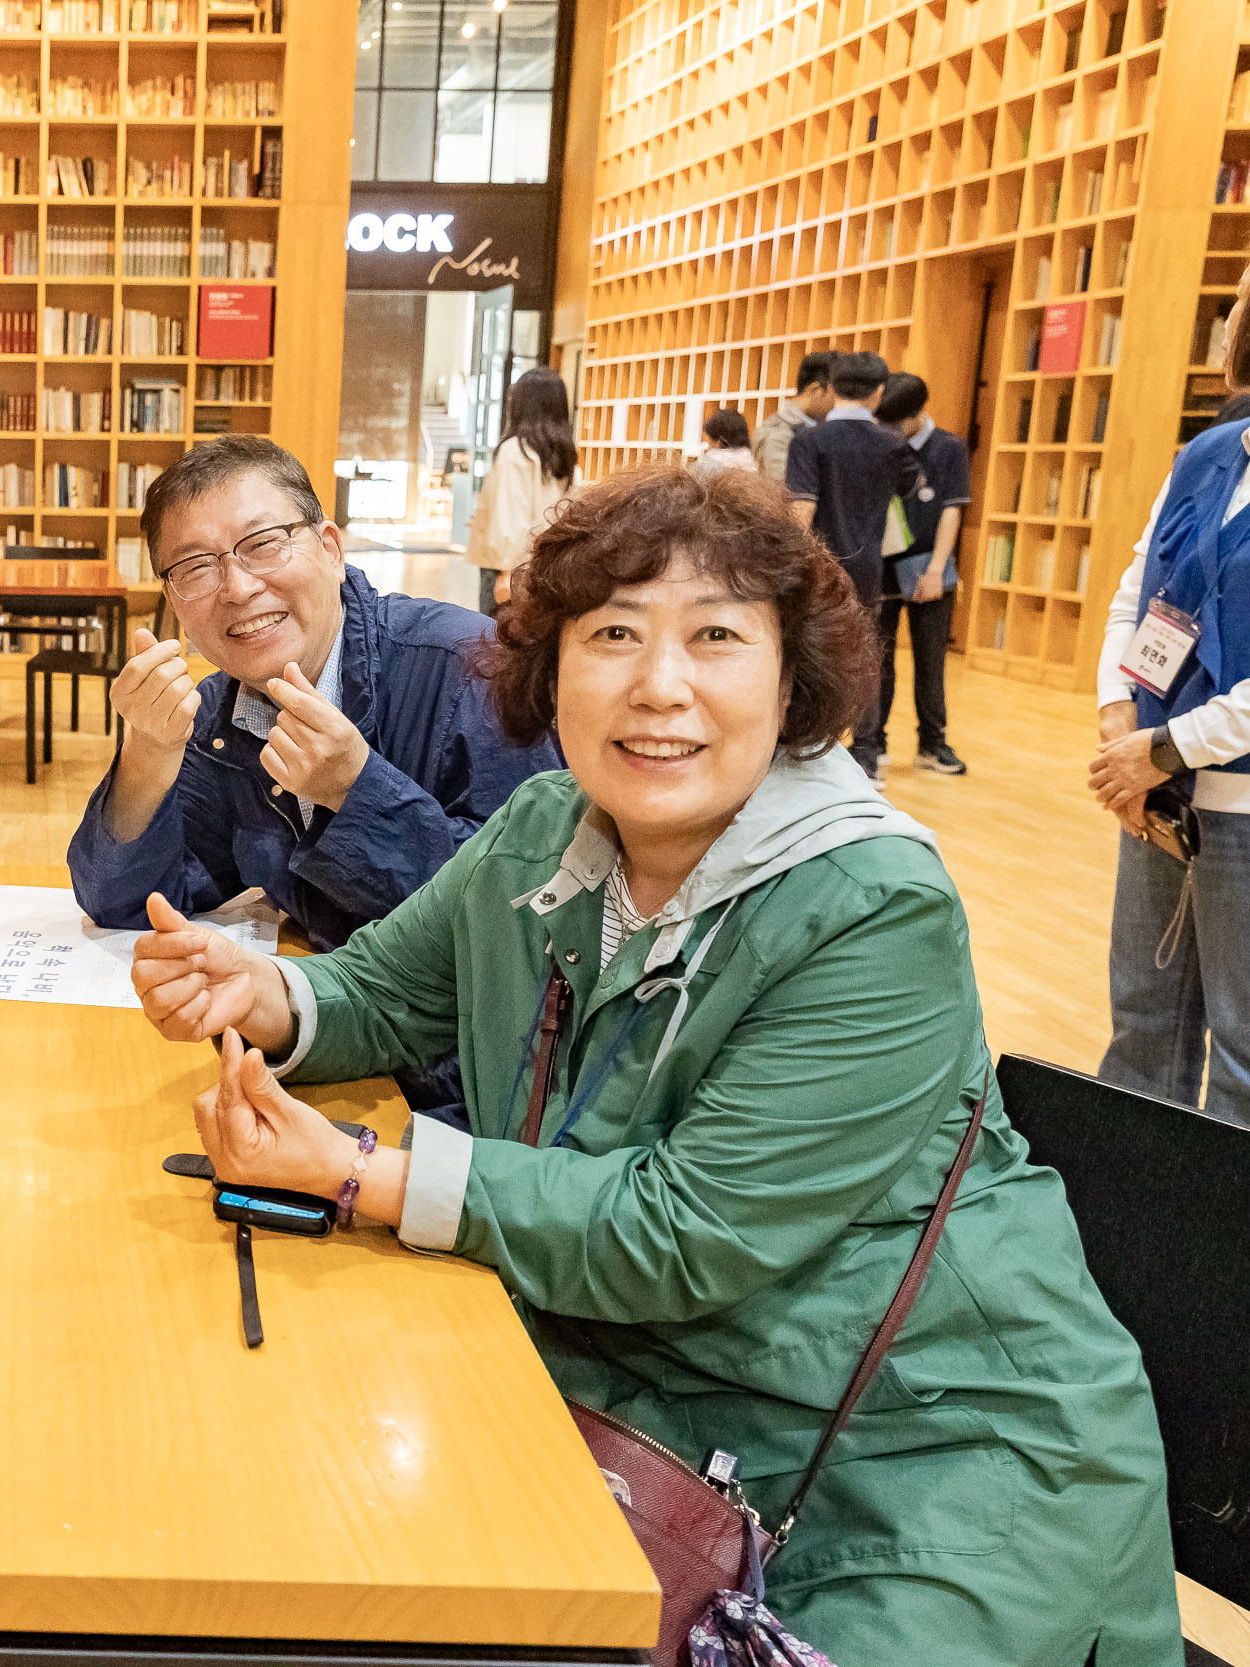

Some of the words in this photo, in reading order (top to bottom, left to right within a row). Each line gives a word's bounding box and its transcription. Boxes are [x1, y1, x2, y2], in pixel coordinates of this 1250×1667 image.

[345, 213, 454, 252] OCK
[0, 930, 43, 968] 음악으로
[35, 957, 67, 967] 속
